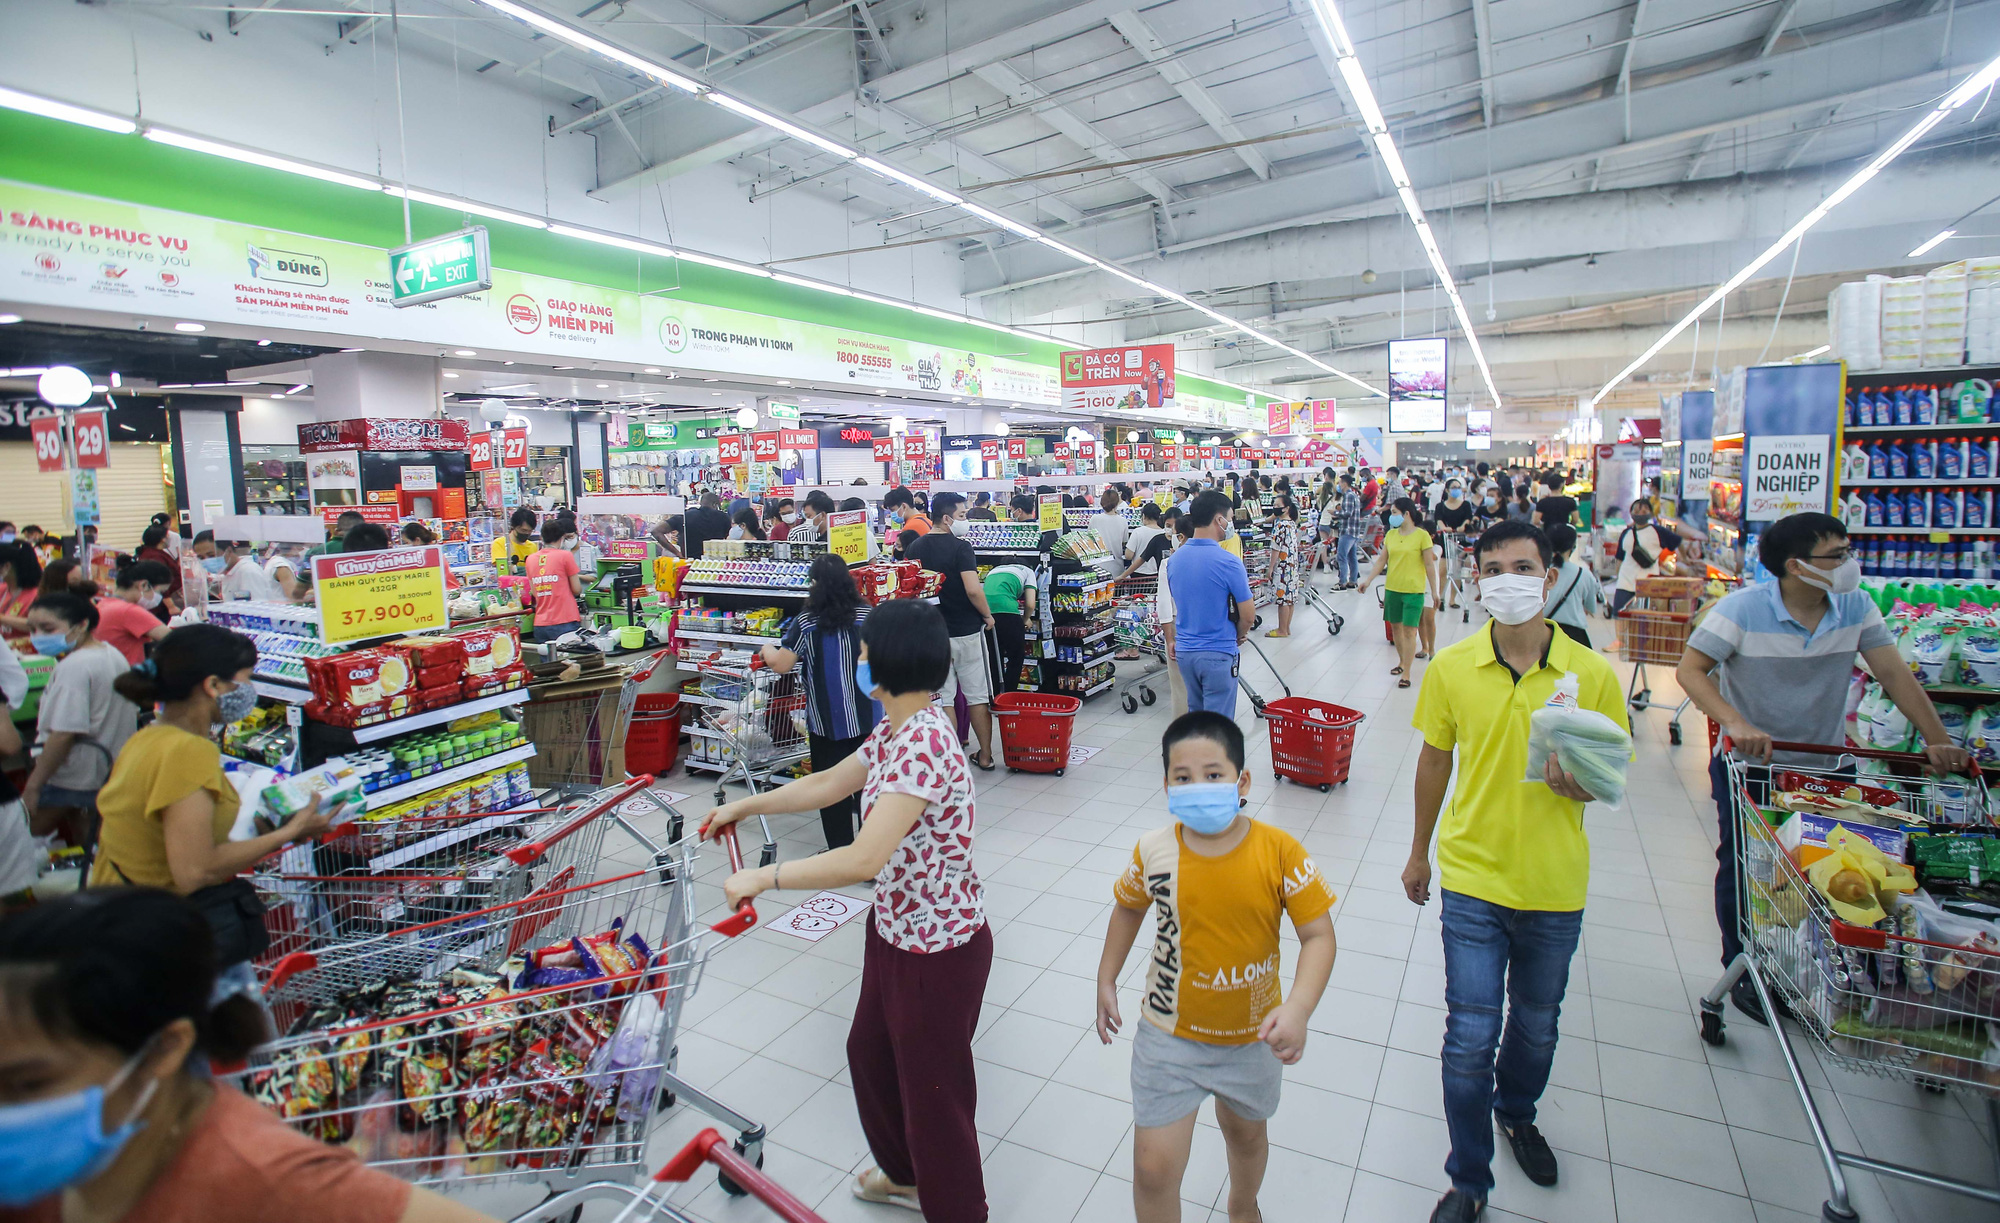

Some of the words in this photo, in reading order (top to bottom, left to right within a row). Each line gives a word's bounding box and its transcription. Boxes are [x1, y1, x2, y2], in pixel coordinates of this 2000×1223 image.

[89, 224, 152, 246] PHỤC
[158, 235, 188, 254] VỤ
[16, 232, 73, 252] ready
[80, 241, 99, 254] to
[106, 245, 154, 262] serve
[161, 253, 191, 267] you
[277, 259, 321, 277] ĐÚNG
[445, 263, 468, 283] EXIT
[234, 284, 265, 294] Khách
[267, 287, 291, 298] hàng
[547, 299, 577, 312] GIAO
[580, 303, 612, 317] HÀNG
[548, 311, 586, 331] MIỄN
[590, 320, 614, 335] PHÍ
[666, 323, 680, 336] 10
[549, 331, 567, 340] Free
[568, 335, 597, 344] delivery
[692, 328, 728, 343] TRONG
[730, 334, 757, 348] PHẠM
[759, 338, 769, 348] VI
[770, 340, 793, 351] 10KM
[692, 343, 713, 352] Within
[714, 345, 730, 353] 10KM
[859, 341, 876, 349] KHÁCH
[837, 351, 859, 364] 1800
[861, 355, 892, 368] 555555
[1086, 353, 1102, 365] ĐÃ
[1104, 351, 1120, 363] CÓ
[1086, 365, 1120, 379] TRÊN
[36, 430, 60, 460] 30
[78, 425, 103, 455] 29
[786, 435, 794, 444] LA
[796, 434, 814, 444] DOUX
[473, 442, 490, 462] 28
[506, 438, 525, 458] 27
[720, 442, 739, 458] 26
[756, 440, 777, 455] 25
[874, 443, 893, 457] 24
[906, 443, 924, 455] 23
[983, 446, 997, 456] 22
[1011, 444, 1023, 454] 21
[1055, 447, 1069, 457] 20
[1081, 445, 1094, 455] 19
[1116, 448, 1127, 457] 18
[1140, 447, 1151, 456] 17
[1690, 452, 1712, 464] DOA
[1757, 453, 1820, 470] DOANH
[1757, 472, 1820, 495] NGHIỆP
[405, 571, 430, 580] MARIE
[342, 603, 414, 625] 37.900
[414, 614, 433, 623] vnd
[349, 667, 375, 679] COSY
[1804, 782, 1829, 793] COSY
